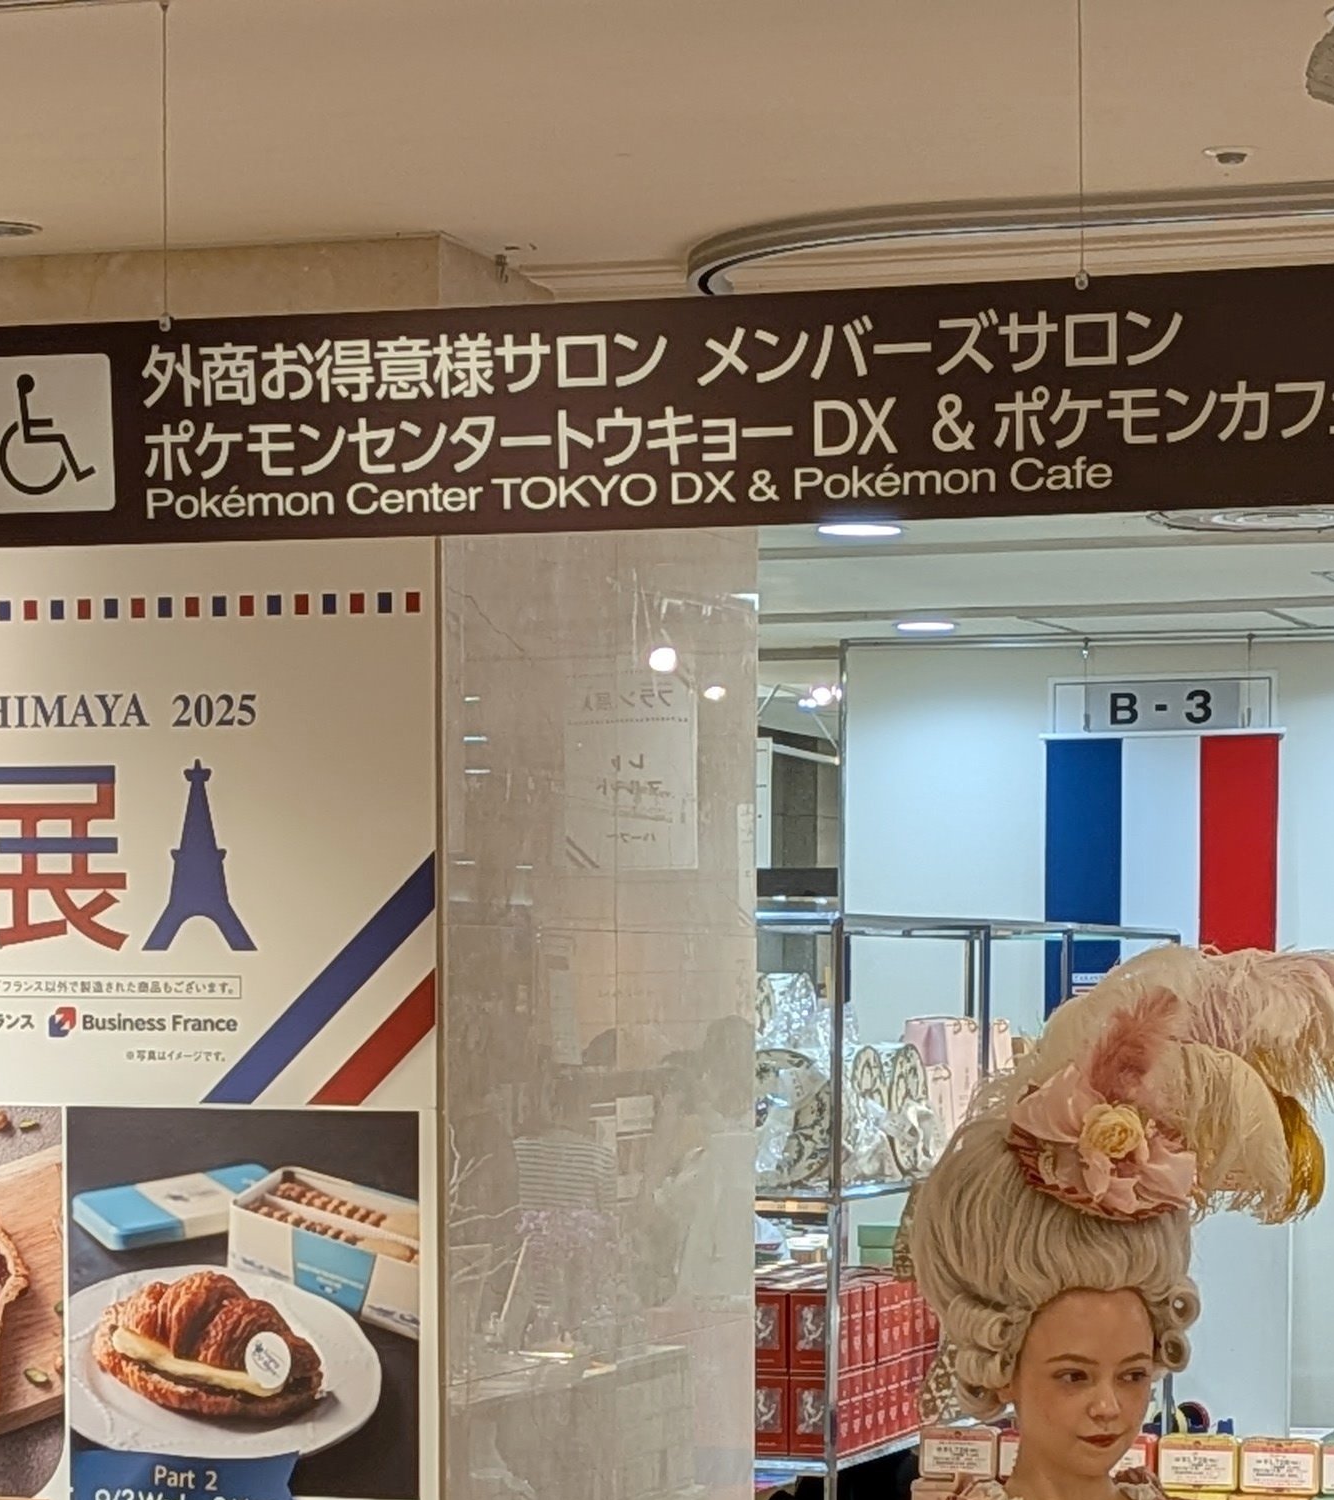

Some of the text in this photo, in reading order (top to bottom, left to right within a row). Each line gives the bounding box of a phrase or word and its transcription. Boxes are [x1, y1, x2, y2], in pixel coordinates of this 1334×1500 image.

[141, 309, 1184, 409] 外商お得意様サロン メンバーズサロン
[144, 404, 793, 480] ポケモンセンタートウキョー
[814, 398, 897, 456] DX
[932, 394, 975, 453] &
[145, 454, 1112, 520] Pokémon Center TOKYO DX & Pokémon Cafe
[172, 693, 258, 728] 2025
[82, 1013, 165, 1032] Business
[172, 1014, 238, 1033] France
[154, 1465, 218, 1491] Part 2
